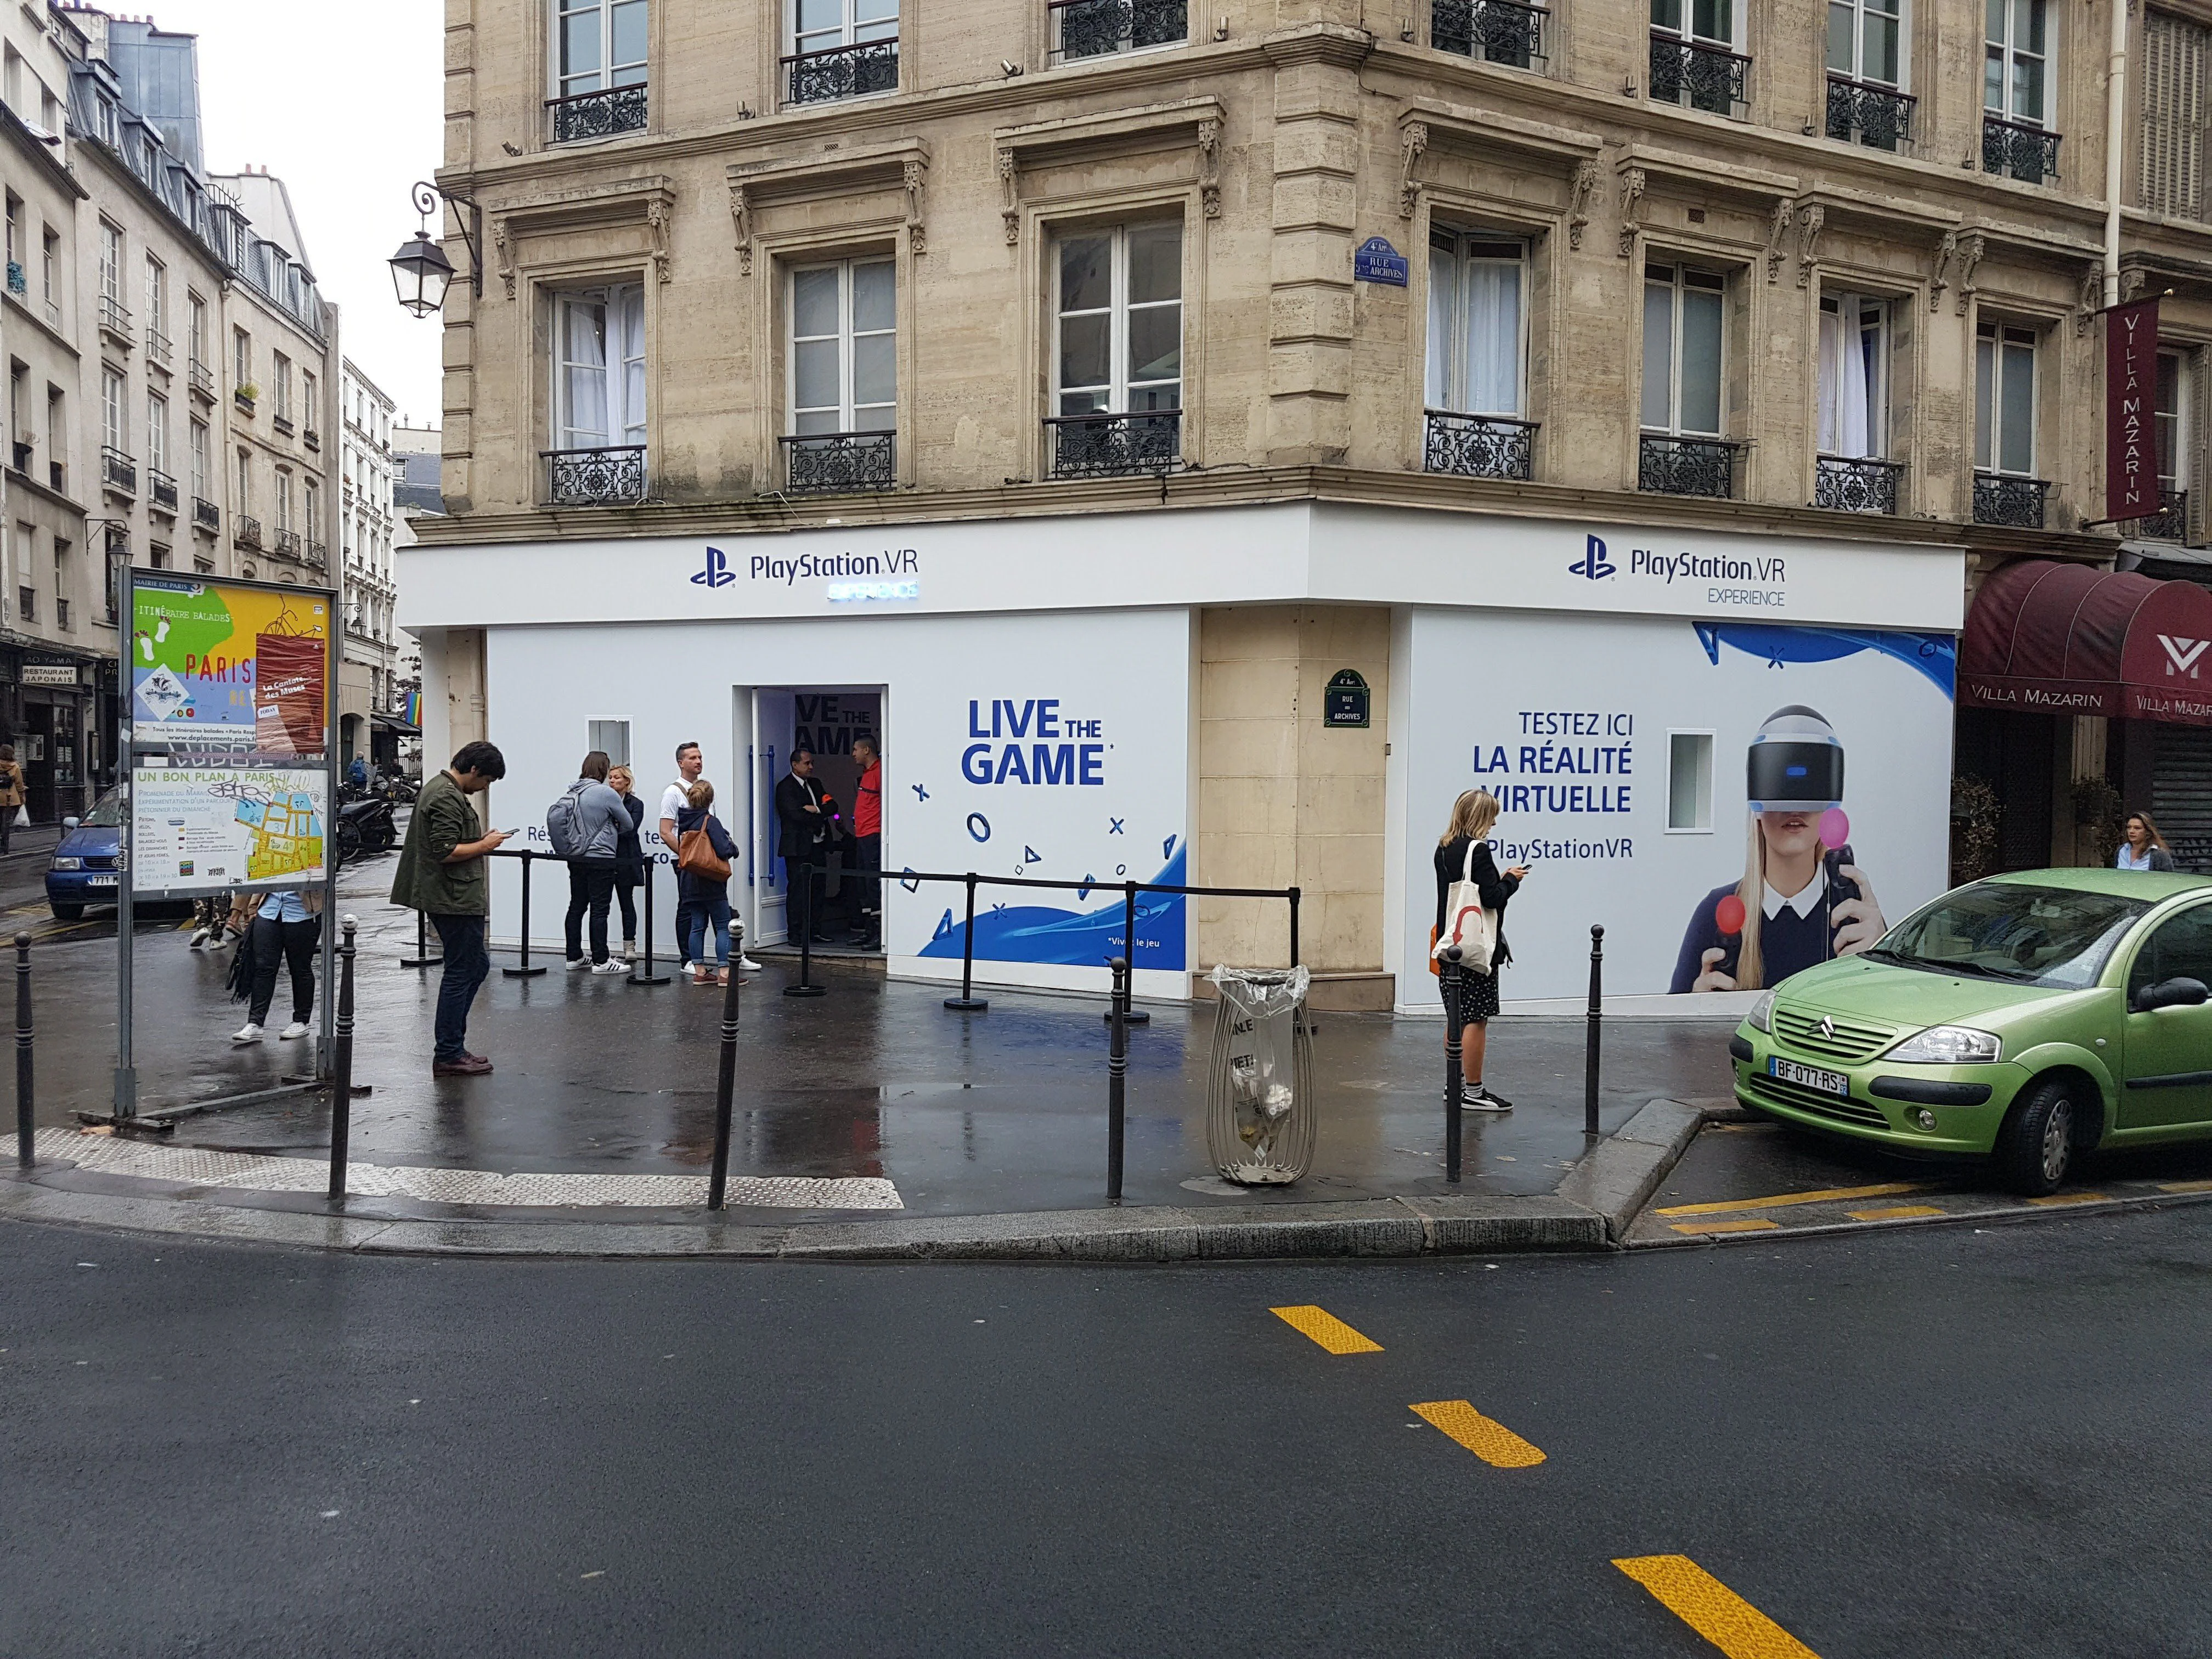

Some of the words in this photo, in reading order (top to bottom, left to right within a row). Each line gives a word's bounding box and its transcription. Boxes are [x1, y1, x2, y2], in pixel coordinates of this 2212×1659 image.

[1370, 257, 1389, 268] RUE
[1370, 267, 1403, 279] ARCHIVES
[2124, 313, 2139, 391] VILLA
[2123, 397, 2140, 505] MAZARIN
[1708, 588, 1785, 606] EXPERIENCE
[193, 611, 230, 623] BALADES
[185, 653, 251, 684] PARIS
[264, 691, 279, 700] des
[280, 684, 306, 696] Muses
[274, 676, 306, 689] Cantate
[1971, 684, 2016, 702] VILLA
[2024, 689, 2103, 707] MAZARIN
[2136, 695, 2170, 713] VILLA
[2175, 699, 2212, 716] MAZAR
[843, 711, 870, 724] THE
[969, 699, 1059, 738] LIVE
[1065, 720, 1102, 738] THE
[1519, 712, 1599, 736] TESTEZ
[1607, 714, 1633, 736] ICI
[1473, 746, 1510, 774] LA
[1519, 740, 1633, 775] RÉALITÉ
[138, 772, 156, 782] UN
[163, 772, 189, 782] BON
[195, 772, 225, 782] PLAN
[245, 772, 275, 782] PARIS
[1481, 785, 1631, 812] VIRTUELLE
[1136, 938, 1144, 946] le
[1146, 939, 1160, 948] jeu
